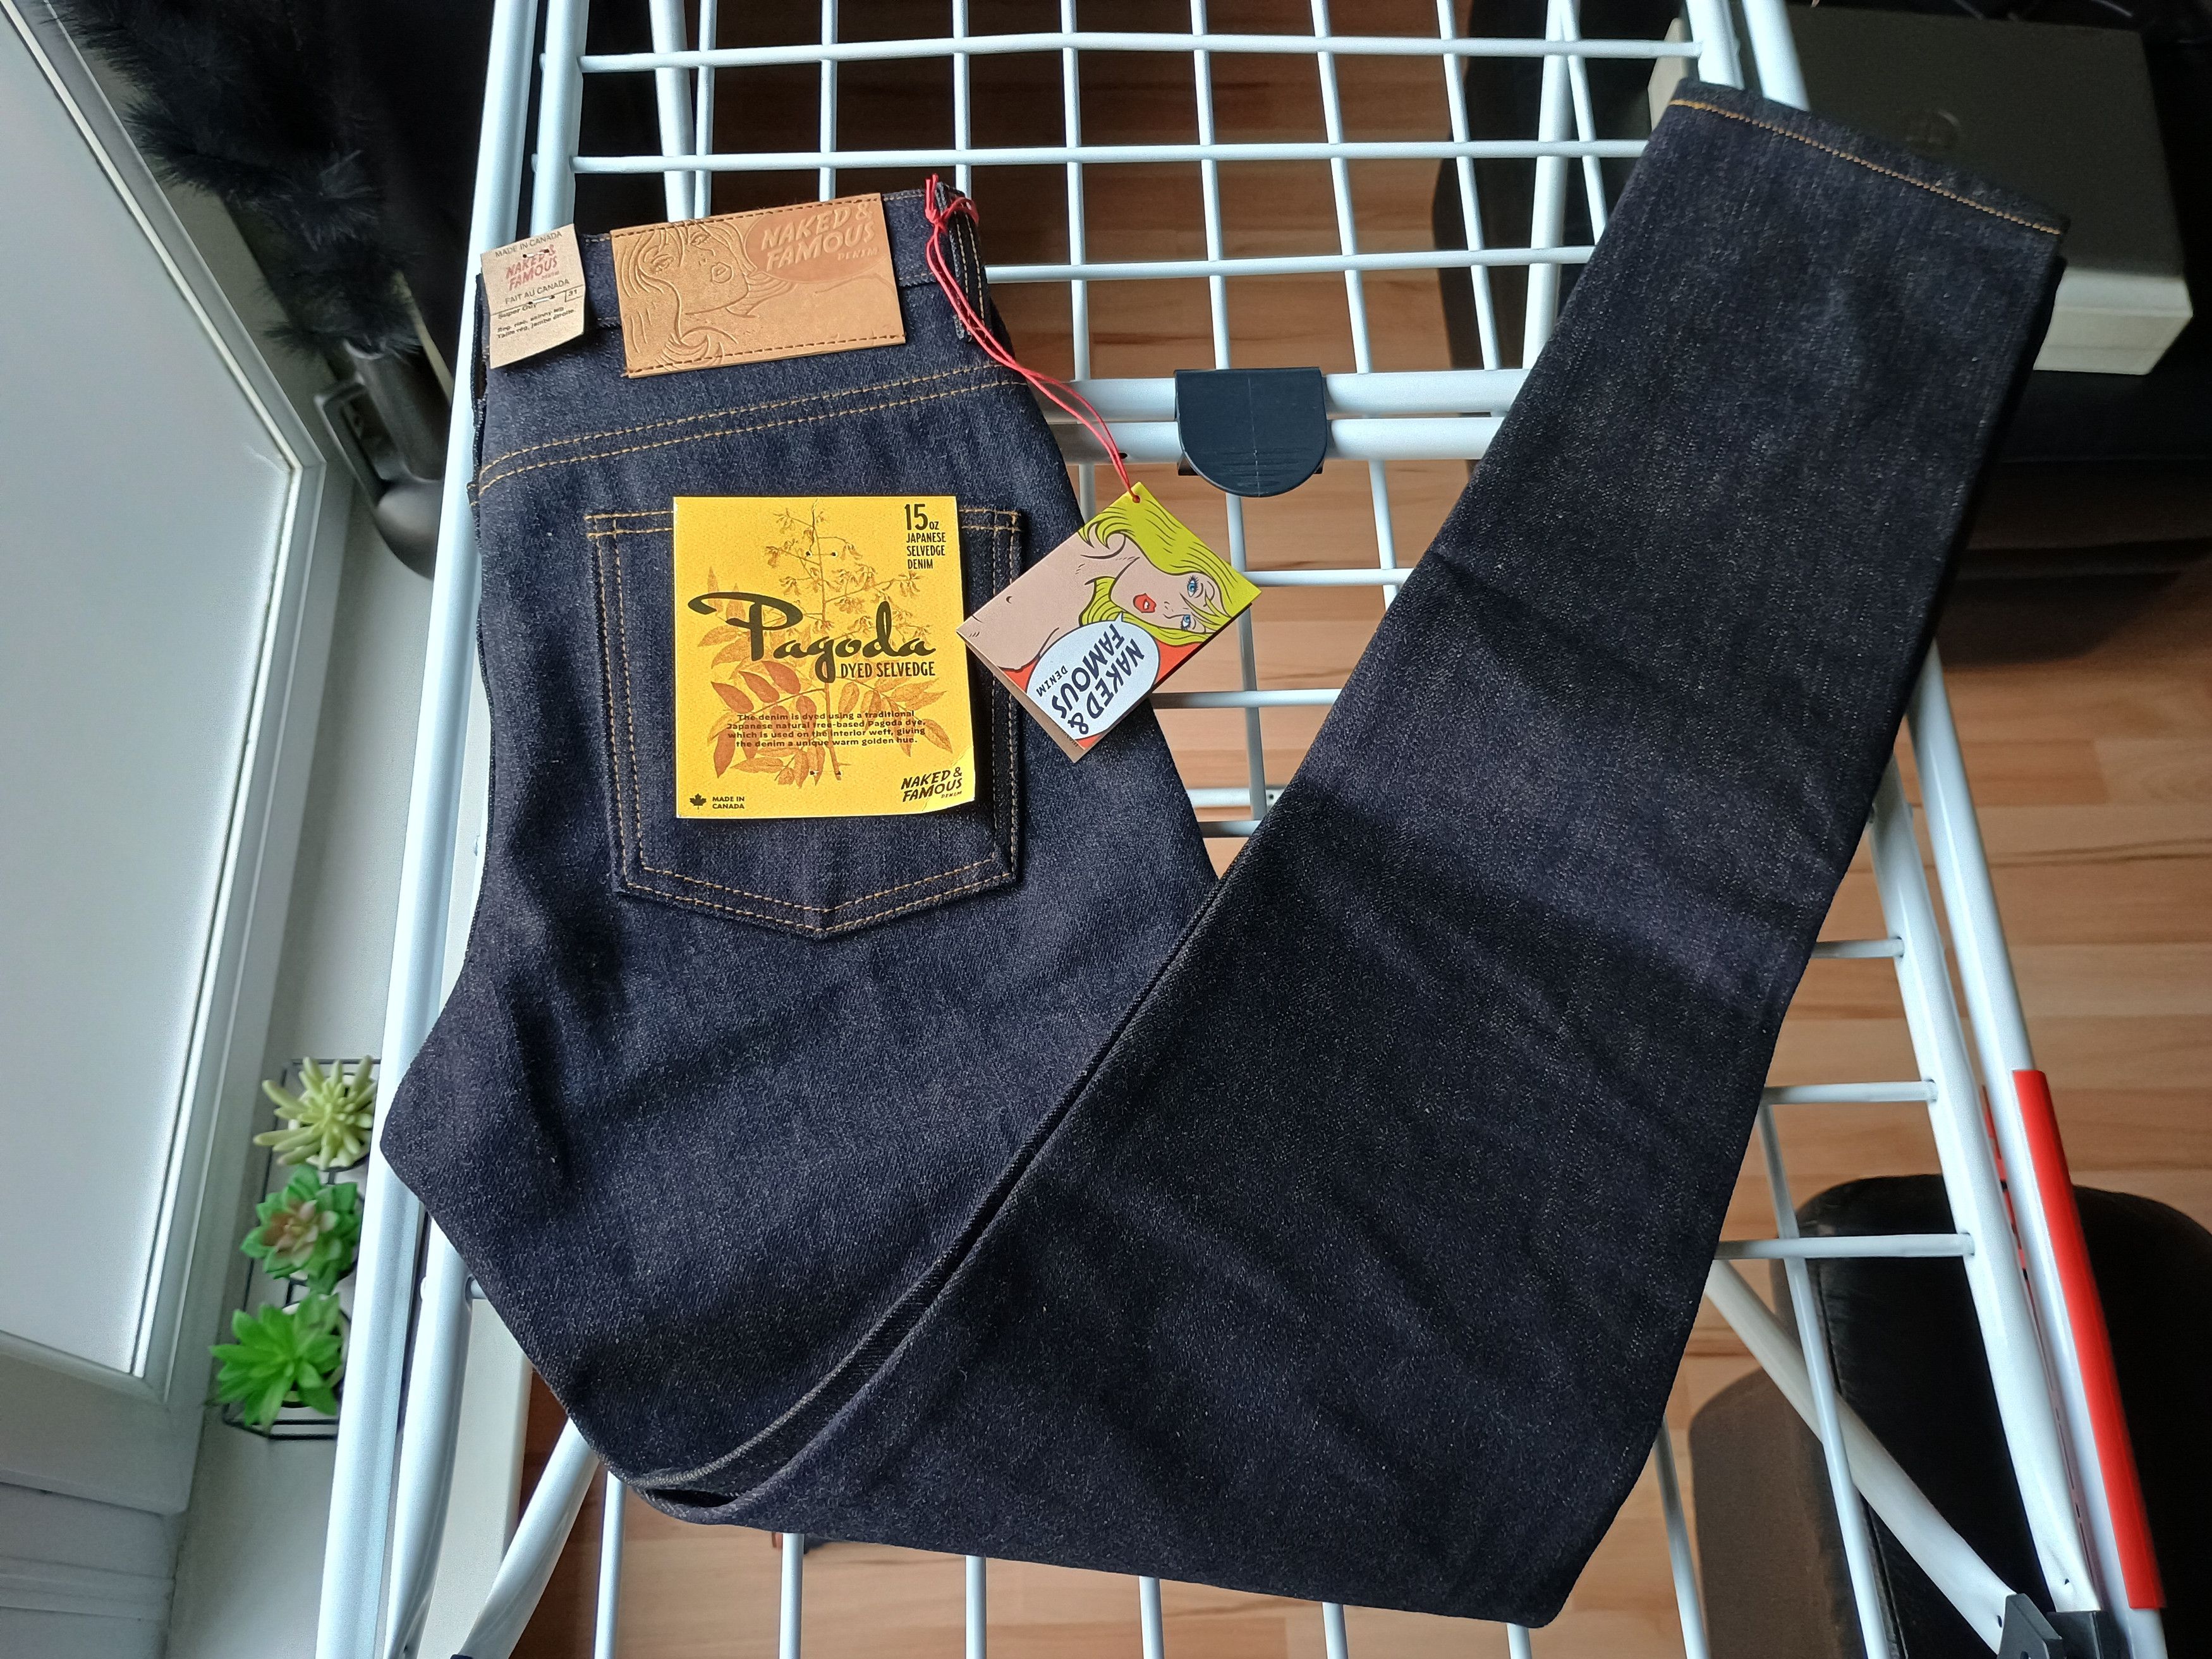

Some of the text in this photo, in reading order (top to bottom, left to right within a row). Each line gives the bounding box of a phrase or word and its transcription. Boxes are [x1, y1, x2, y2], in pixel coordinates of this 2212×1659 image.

[761, 202, 873, 251] NAKED &
[495, 231, 562, 258] MADE IN CANADA
[767, 221, 875, 272] FAMOUS
[837, 247, 879, 261] DENIM
[506, 250, 545, 279] NAKED
[508, 255, 557, 291] FAMOUS
[505, 279, 570, 304] FAIT AU CANADA
[906, 532, 947, 544] JAPANESE
[906, 545, 945, 556] SELVEDGE
[908, 559, 933, 569] DENIM
[687, 592, 937, 683] Pagoda
[841, 662, 935, 678] DYED SELVEDGE
[1036, 665, 1068, 697] DENIM
[1052, 623, 1125, 719] FAMOUS
[1086, 638, 1145, 719] NAKED
[802, 713, 825, 721] dyed
[865, 710, 914, 719] traditional
[813, 721, 865, 729] tree-based
[868, 719, 902, 727] Pagoda
[905, 719, 926, 727] dye,
[1067, 712, 1090, 735] &
[796, 739, 829, 748] unique
[861, 737, 894, 746] golden
[897, 727, 925, 736] giving
[901, 767, 962, 789] NAKED &
[902, 778, 962, 802] FAMOUS
